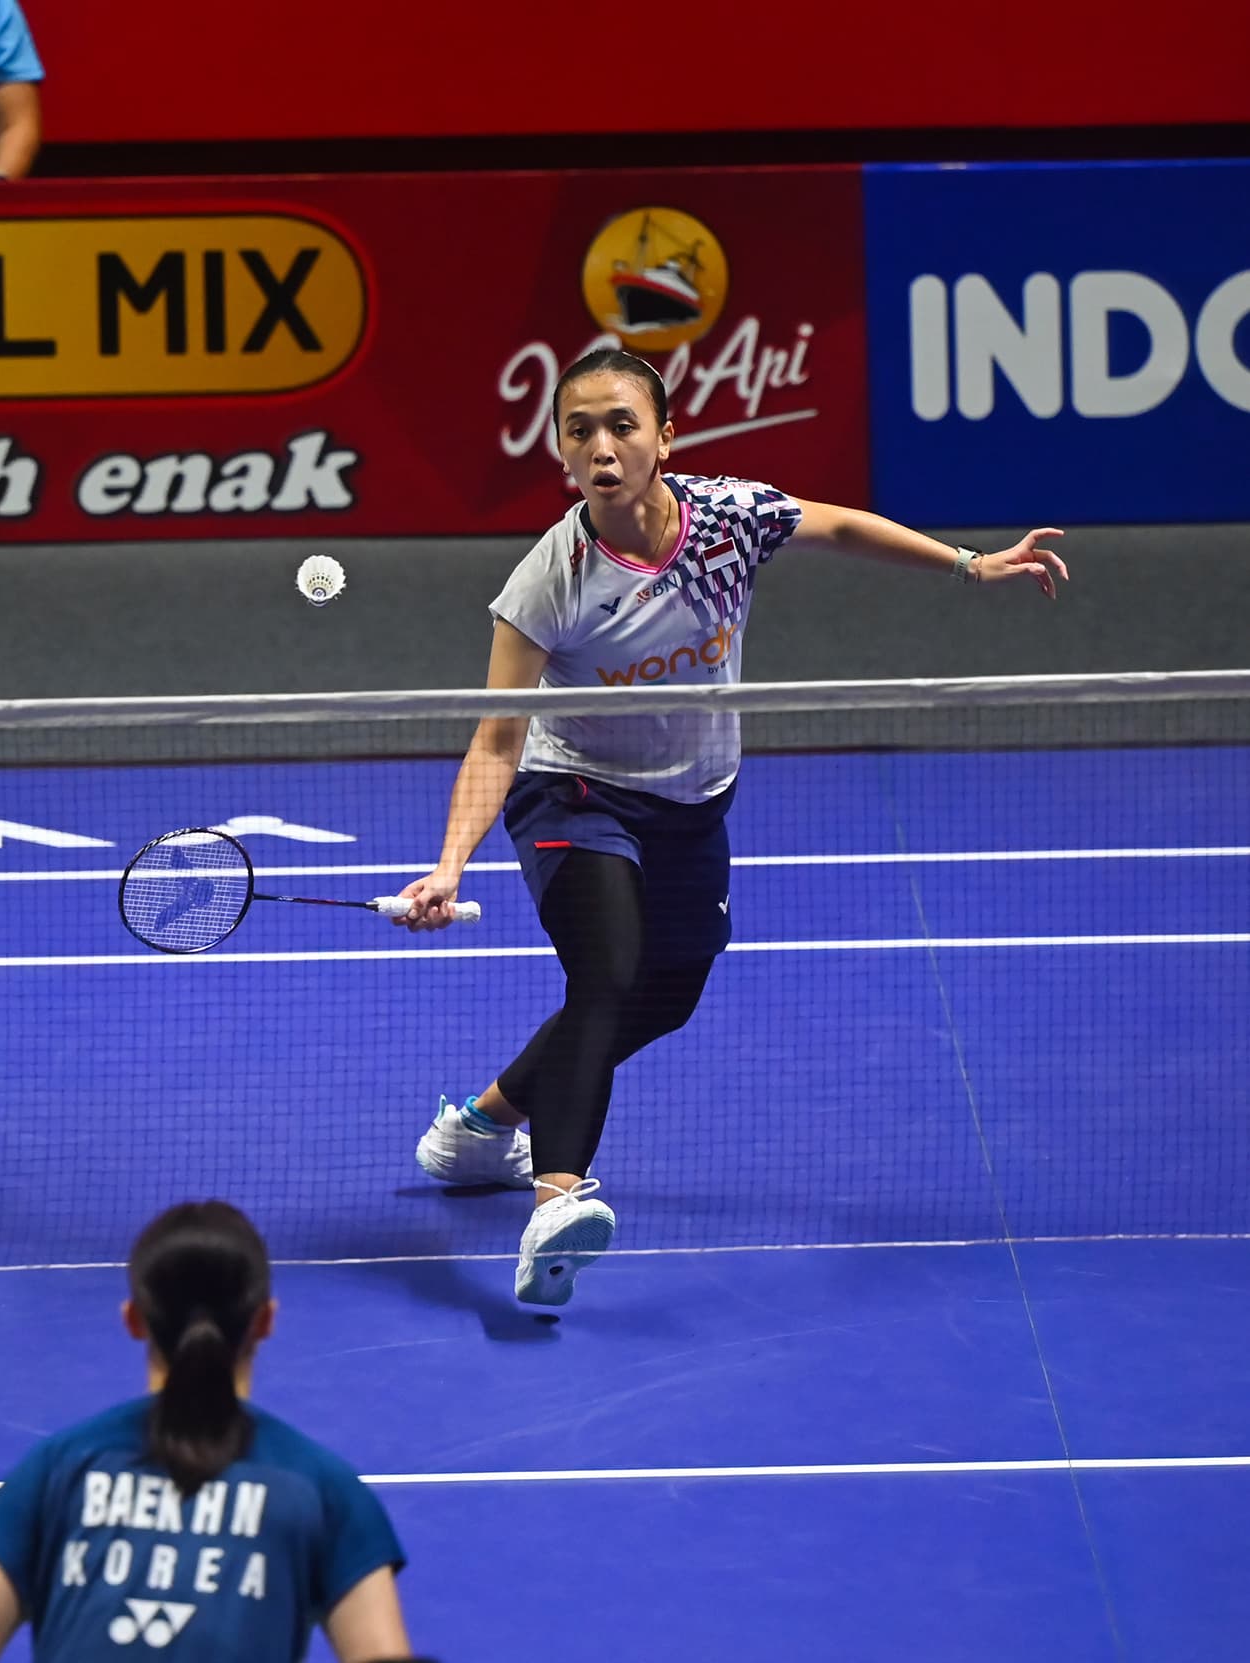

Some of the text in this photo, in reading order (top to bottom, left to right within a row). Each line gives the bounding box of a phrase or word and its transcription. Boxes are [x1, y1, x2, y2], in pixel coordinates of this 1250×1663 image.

[97, 248, 324, 355] MIX
[693, 317, 815, 418] Api
[78, 431, 357, 515] enak
[596, 624, 737, 687] wondr
[61, 1539, 266, 1600] KOREA
